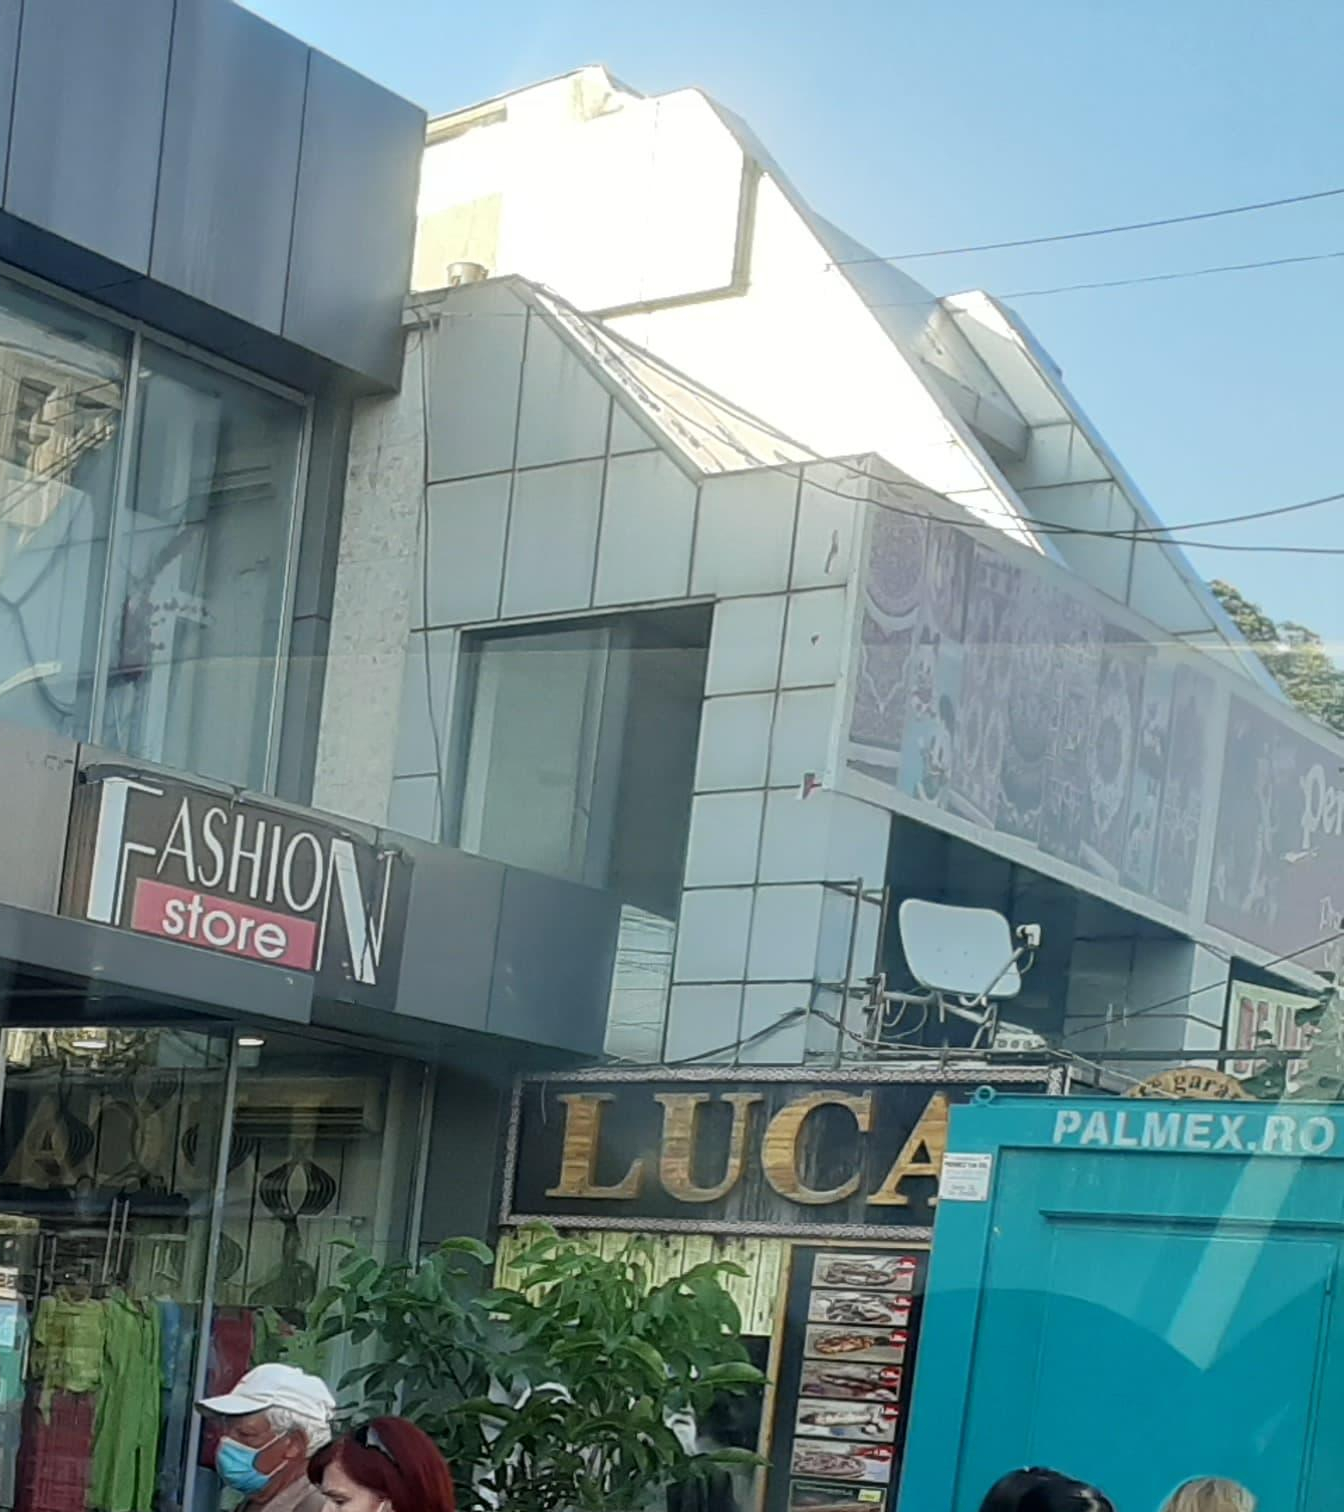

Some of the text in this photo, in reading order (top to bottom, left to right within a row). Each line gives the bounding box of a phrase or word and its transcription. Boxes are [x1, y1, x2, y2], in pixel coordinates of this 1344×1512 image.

[86, 776, 398, 985] FASHION
[161, 896, 289, 961] store
[545, 1090, 950, 1208] LUCA
[1052, 1110, 1335, 1155] PALMEX.RO
